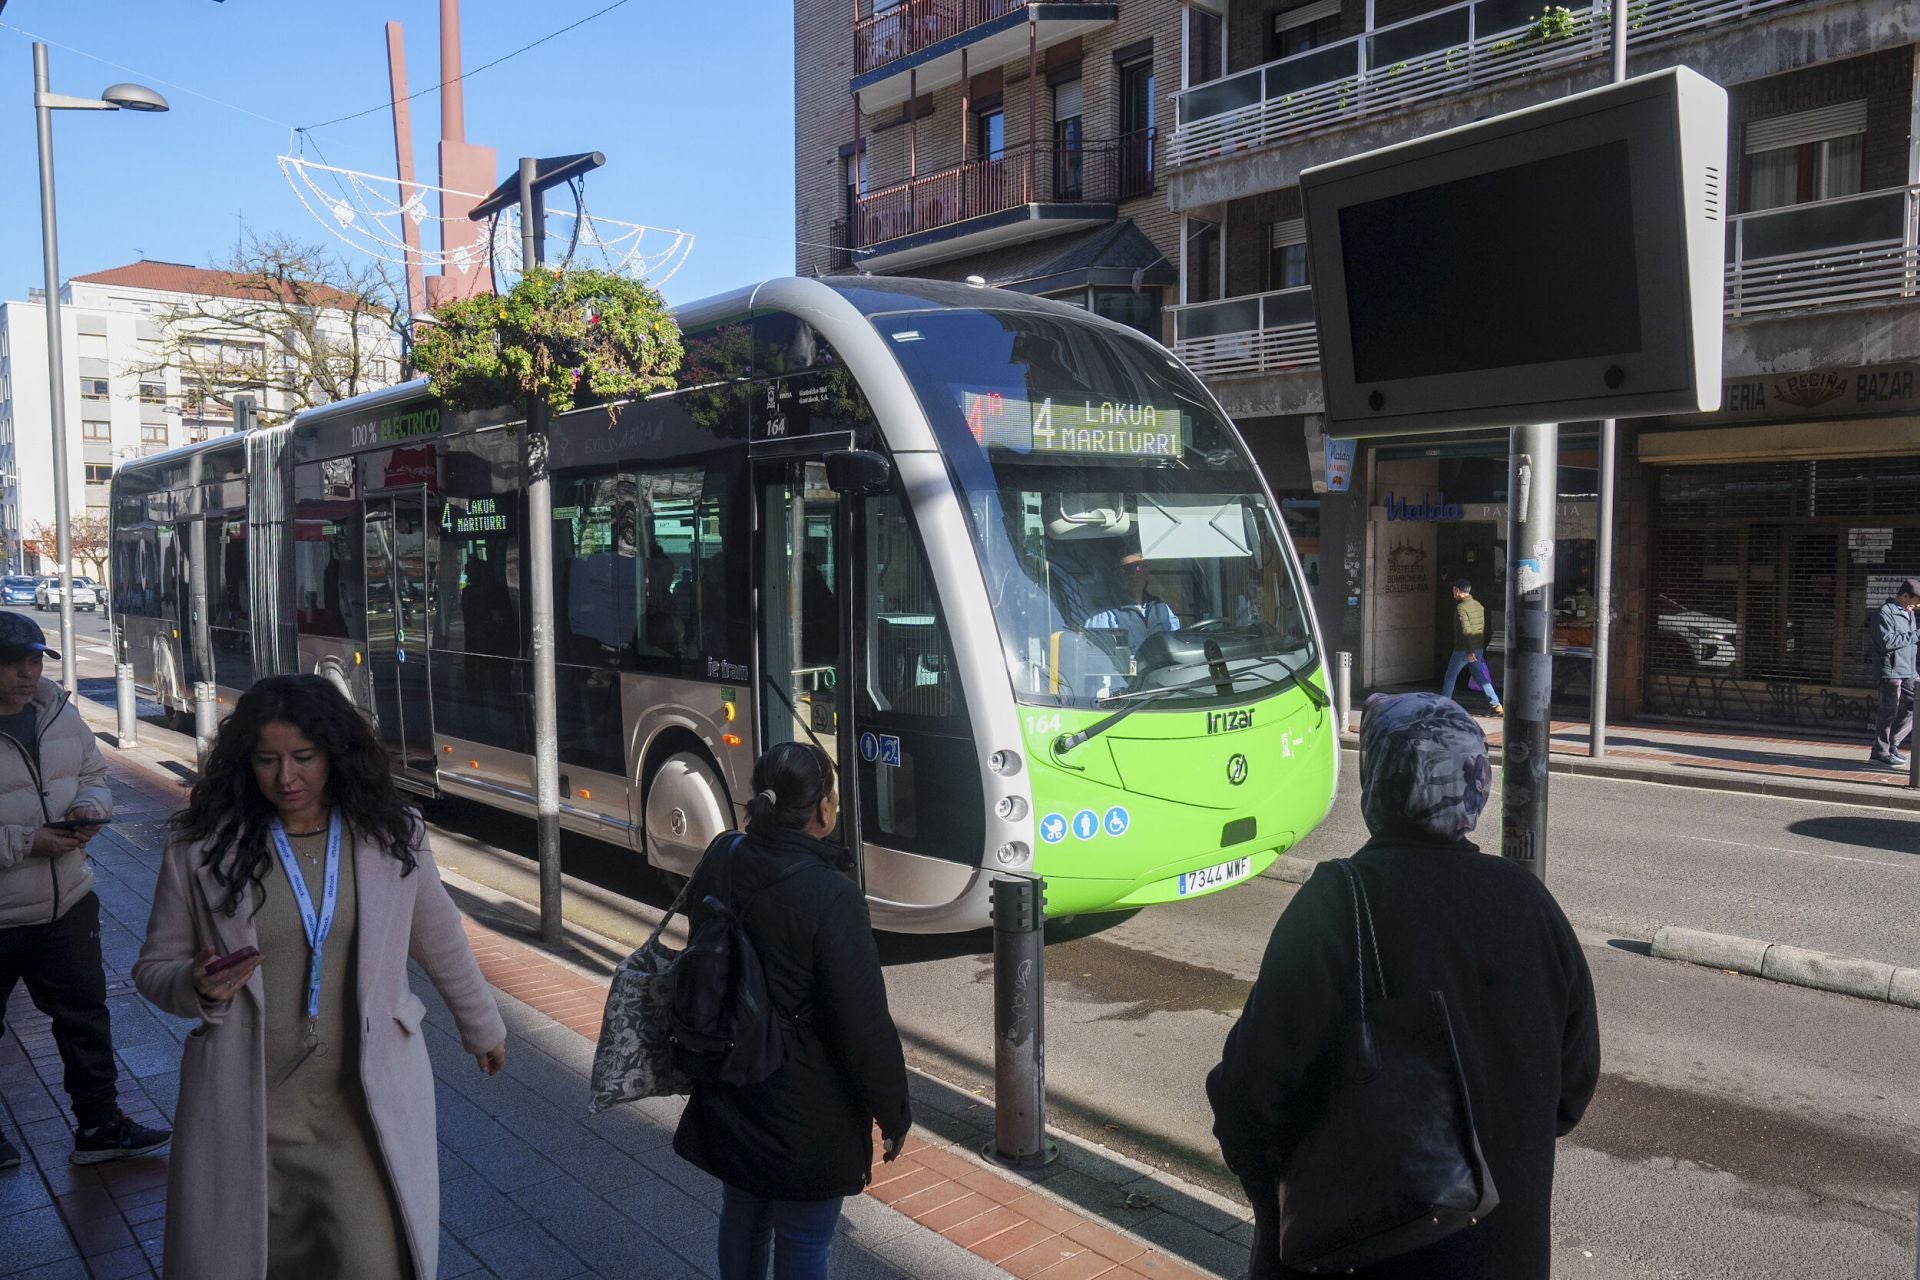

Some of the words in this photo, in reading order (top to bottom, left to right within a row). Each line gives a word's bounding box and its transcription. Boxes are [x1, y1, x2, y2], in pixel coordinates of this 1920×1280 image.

[1856, 370, 1913, 403] BAZAR
[1032, 397, 1056, 449] 4
[1085, 400, 1156, 426] LAKUA
[766, 418, 785, 436] 164
[1062, 428, 1182, 456] MARITURRI
[441, 502, 453, 533] 4
[465, 499, 496, 515] LAKUA
[1483, 504, 1580, 517] PASRIA
[457, 515, 507, 532] MARITURRI
[720, 659, 749, 681] tram
[1026, 713, 1060, 736] 164
[1207, 707, 1256, 735] Irizar
[1188, 864, 1222, 890] 7344
[1226, 855, 1248, 880] MWF
